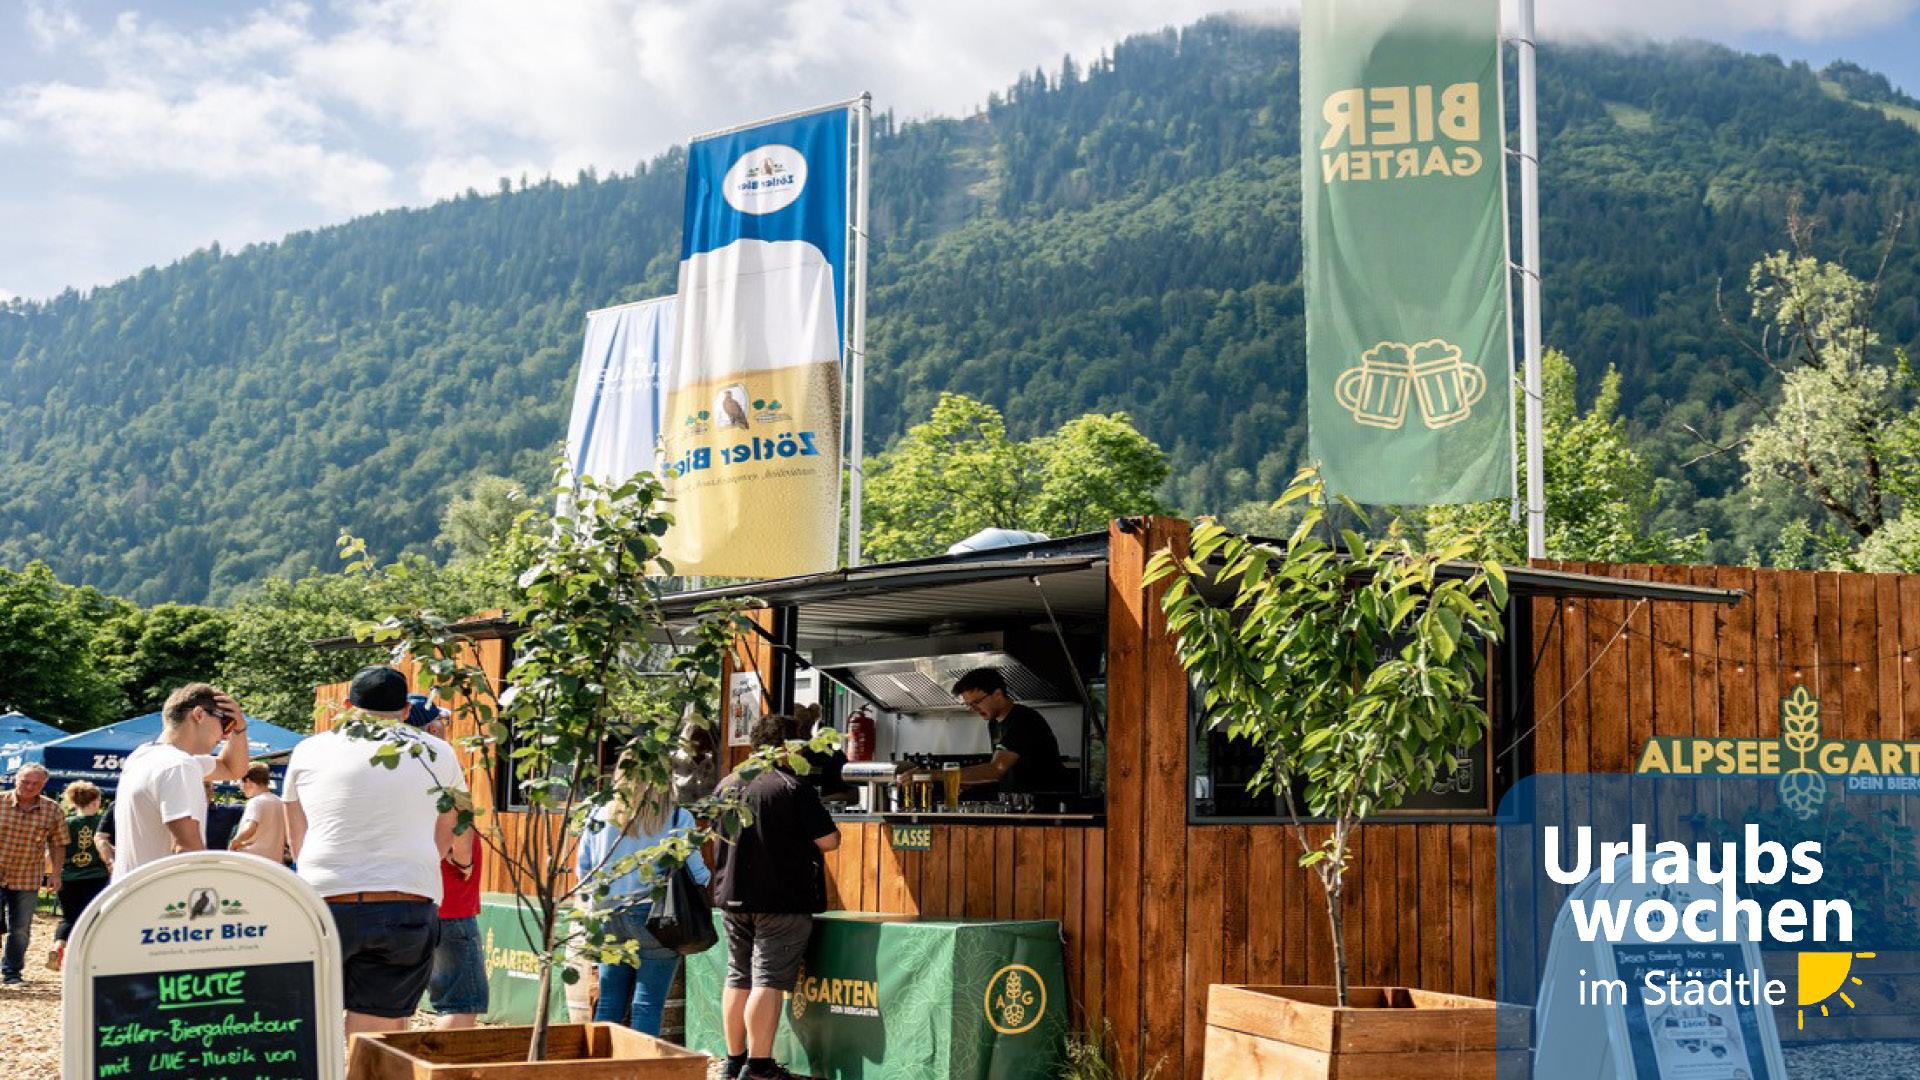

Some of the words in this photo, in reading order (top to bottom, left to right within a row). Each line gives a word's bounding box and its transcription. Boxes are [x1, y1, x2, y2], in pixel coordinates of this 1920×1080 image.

[1638, 740, 1780, 774] ALPSEE
[1848, 776, 1883, 790] DEIN
[893, 828, 931, 847] KASSE
[141, 926, 215, 945] Zötler
[221, 922, 268, 940] Bier
[158, 970, 246, 1003] HEUTE
[804, 976, 879, 1008] GARTEN
[995, 993, 1006, 1009] A
[1022, 990, 1034, 1006] G
[100, 1056, 131, 1078] mit
[264, 1050, 298, 1063] von
